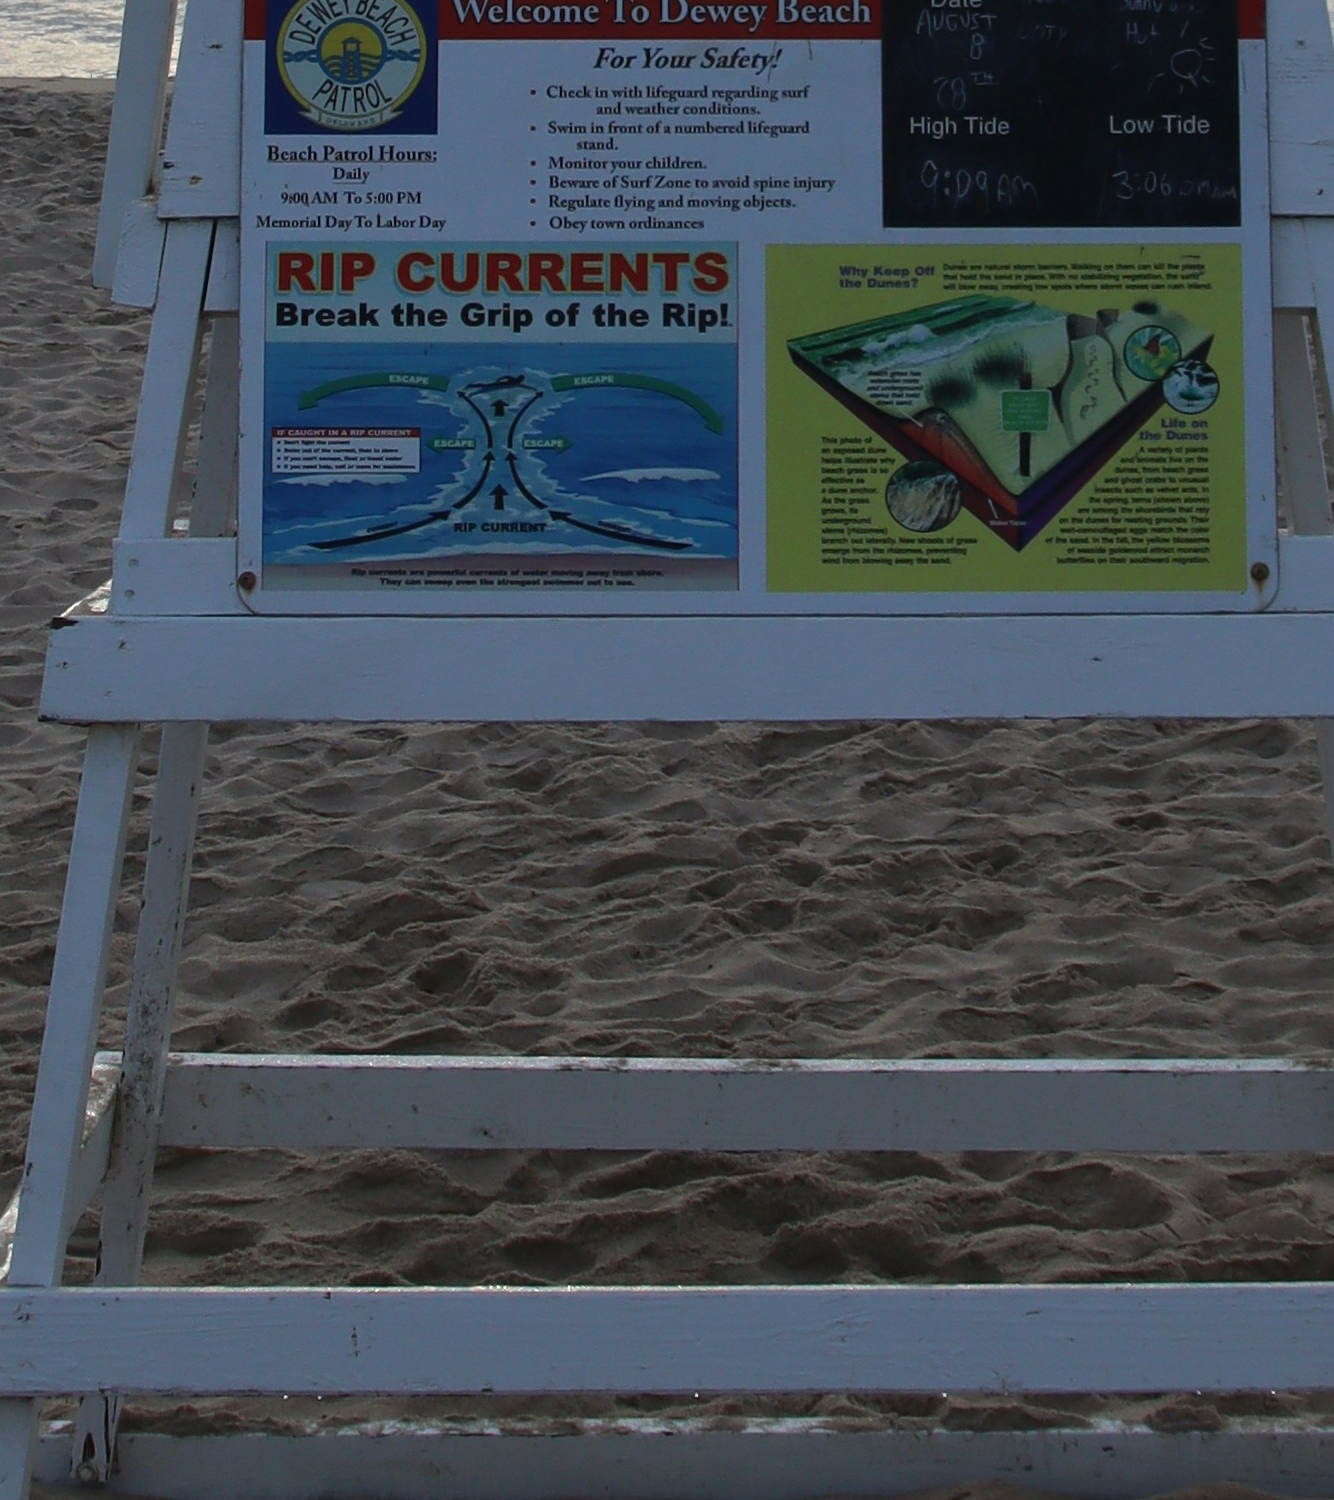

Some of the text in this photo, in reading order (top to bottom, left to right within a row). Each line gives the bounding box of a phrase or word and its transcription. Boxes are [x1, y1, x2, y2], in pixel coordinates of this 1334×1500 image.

[593, 47, 782, 76] For Your Safety!
[312, 78, 393, 114] PATROL
[547, 85, 811, 102] Check in with lifeguard regarding surf
[596, 102, 761, 115] and weather conditions.
[548, 120, 809, 138] Swim in front of a numbered lifeguard
[911, 117, 1009, 139] High Tide
[1110, 115, 1209, 134] Low Tide
[577, 137, 618, 150] stand.
[267, 145, 438, 162] Beach Patrol Hours:
[549, 156, 707, 173] Monitor your children.
[333, 167, 369, 184] Daily
[549, 175, 835, 192] Beware of Surf Zone to avoid spine injury
[920, 159, 989, 212] 9:09
[281, 192, 421, 204] 9:00 AM To 5:00 PM
[549, 194, 795, 212] Regulate flying and moving objects.
[257, 214, 446, 232] Memorial Day To Labor Day
[549, 216, 705, 233] Obey town ordinances
[278, 252, 729, 294] RIP CURRENTS
[839, 266, 868, 277] Why
[873, 266, 910, 278] Keep
[915, 266, 935, 276] Off
[839, 278, 918, 288] the Dunes?
[276, 302, 729, 333] Break the Grip of the Rip!
[389, 375, 429, 385] ESCAPE
[573, 374, 614, 385] ESCAPE
[1161, 418, 1208, 428] Life on
[433, 439, 475, 448] ESCAPE
[523, 439, 564, 448] ESCAPE
[1139, 430, 1208, 440] the Dunes
[454, 522, 547, 532] RIP CURRENT
